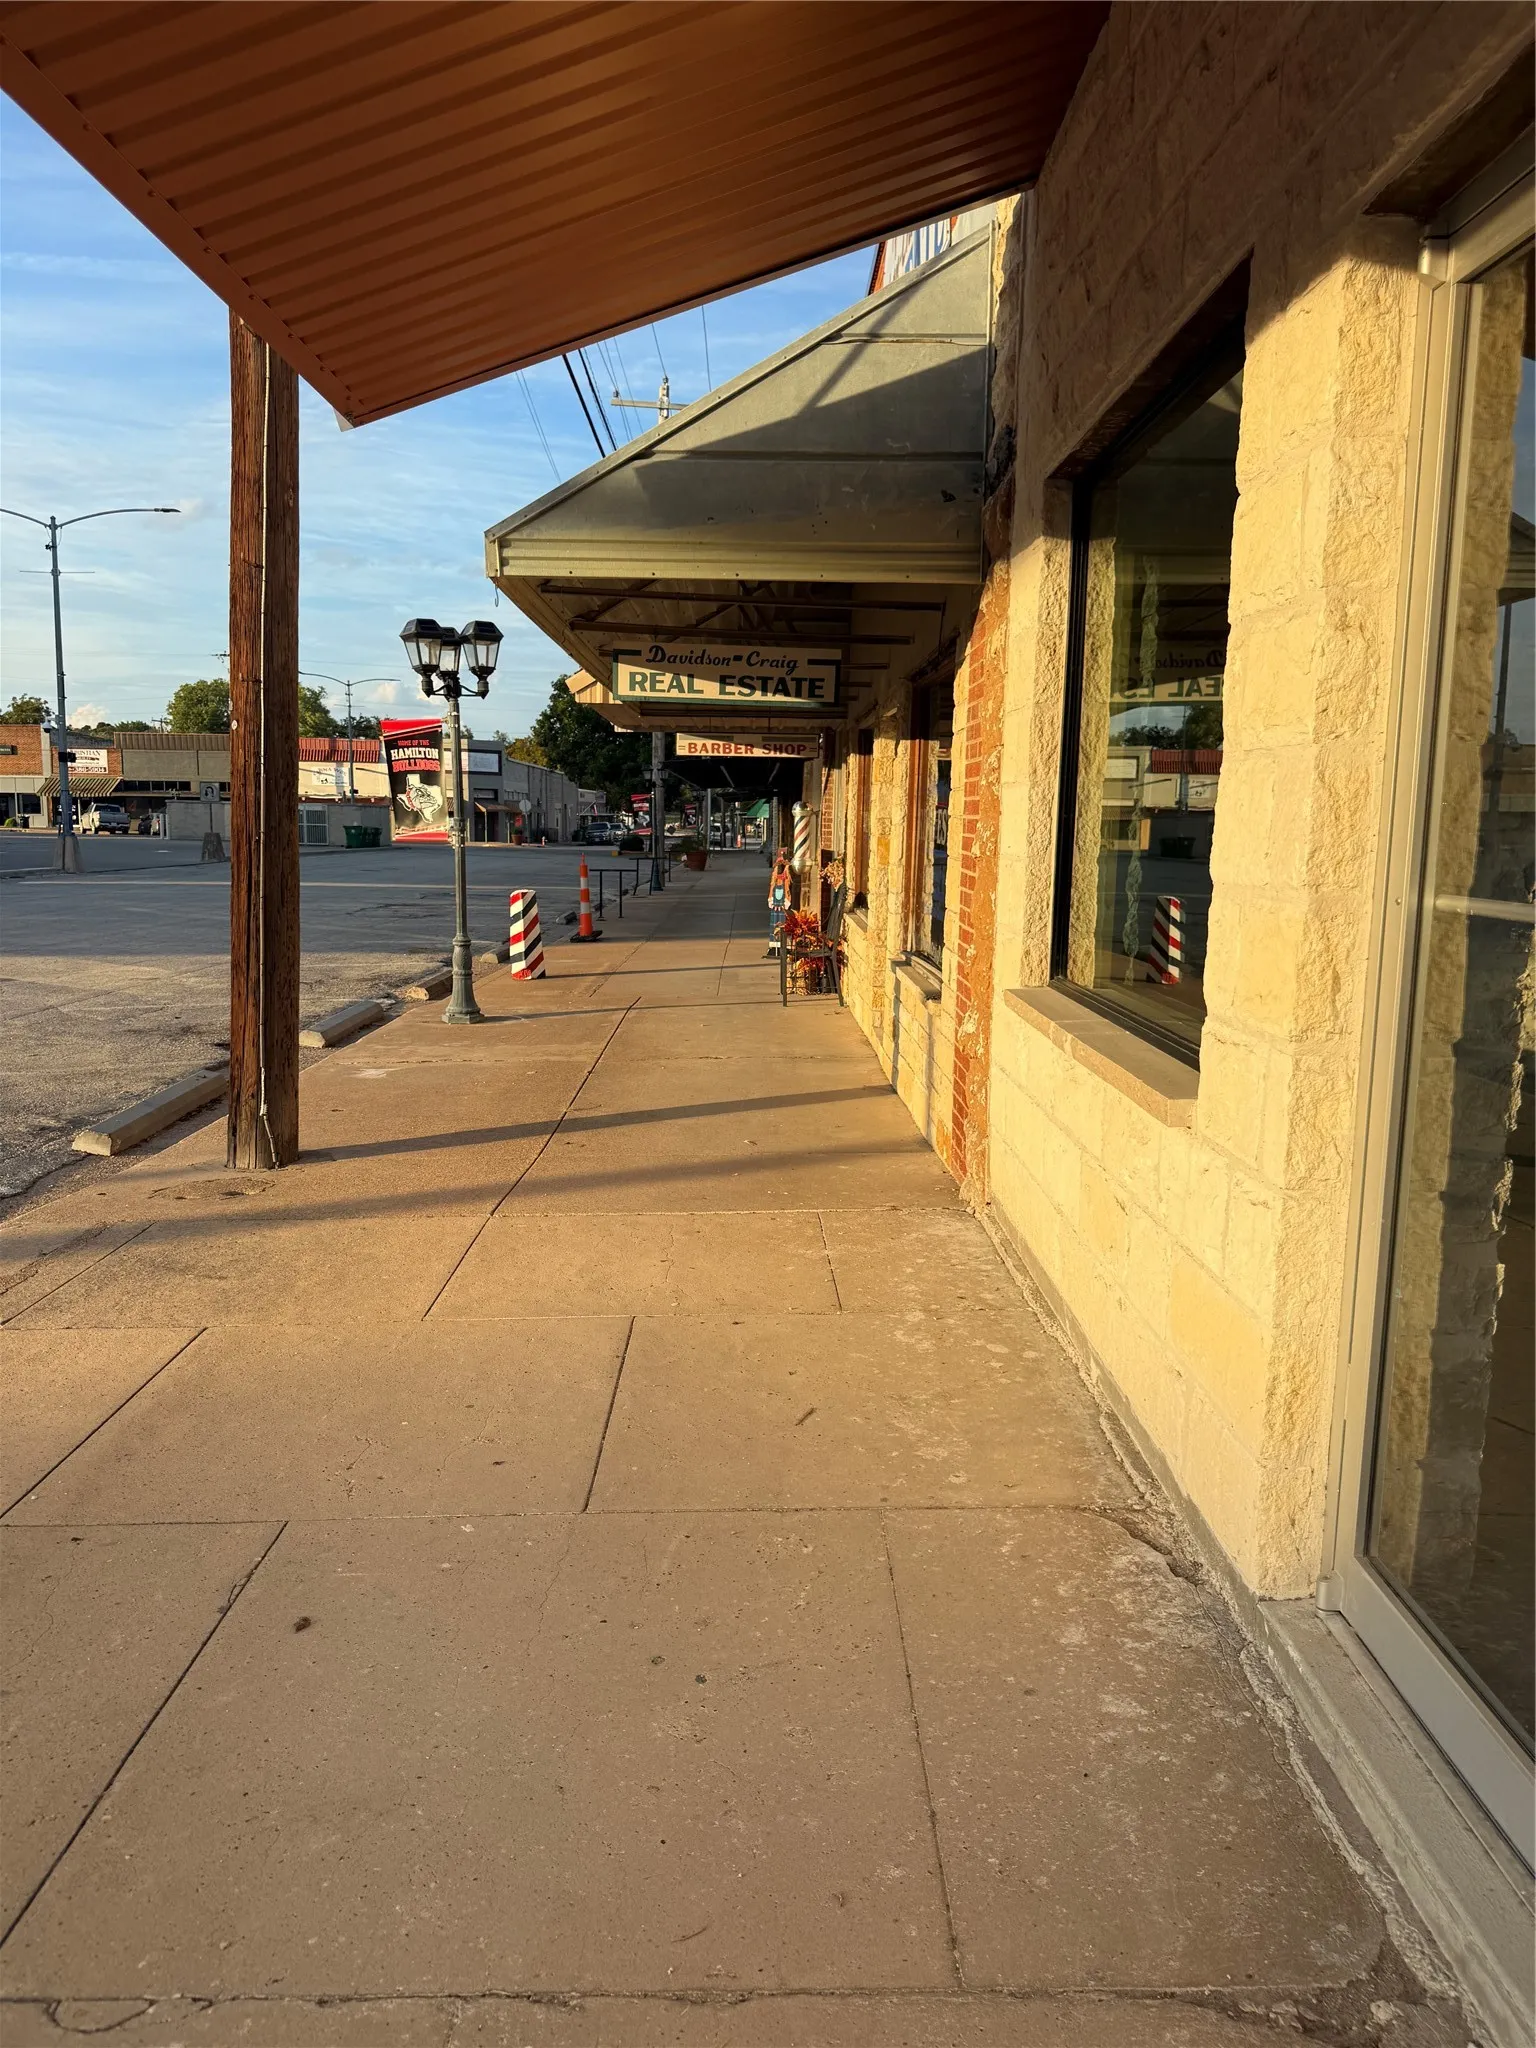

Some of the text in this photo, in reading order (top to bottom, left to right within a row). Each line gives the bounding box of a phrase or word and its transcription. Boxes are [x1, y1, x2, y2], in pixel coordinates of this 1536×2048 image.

[645, 645, 799, 675] Davidson-Craig
[629, 671, 825, 699] REAL ESTATE
[390, 747, 439, 760] HAMILTON
[687, 742, 807, 756] BARBER SHOP
[392, 759, 441, 772] BULLDOGS
